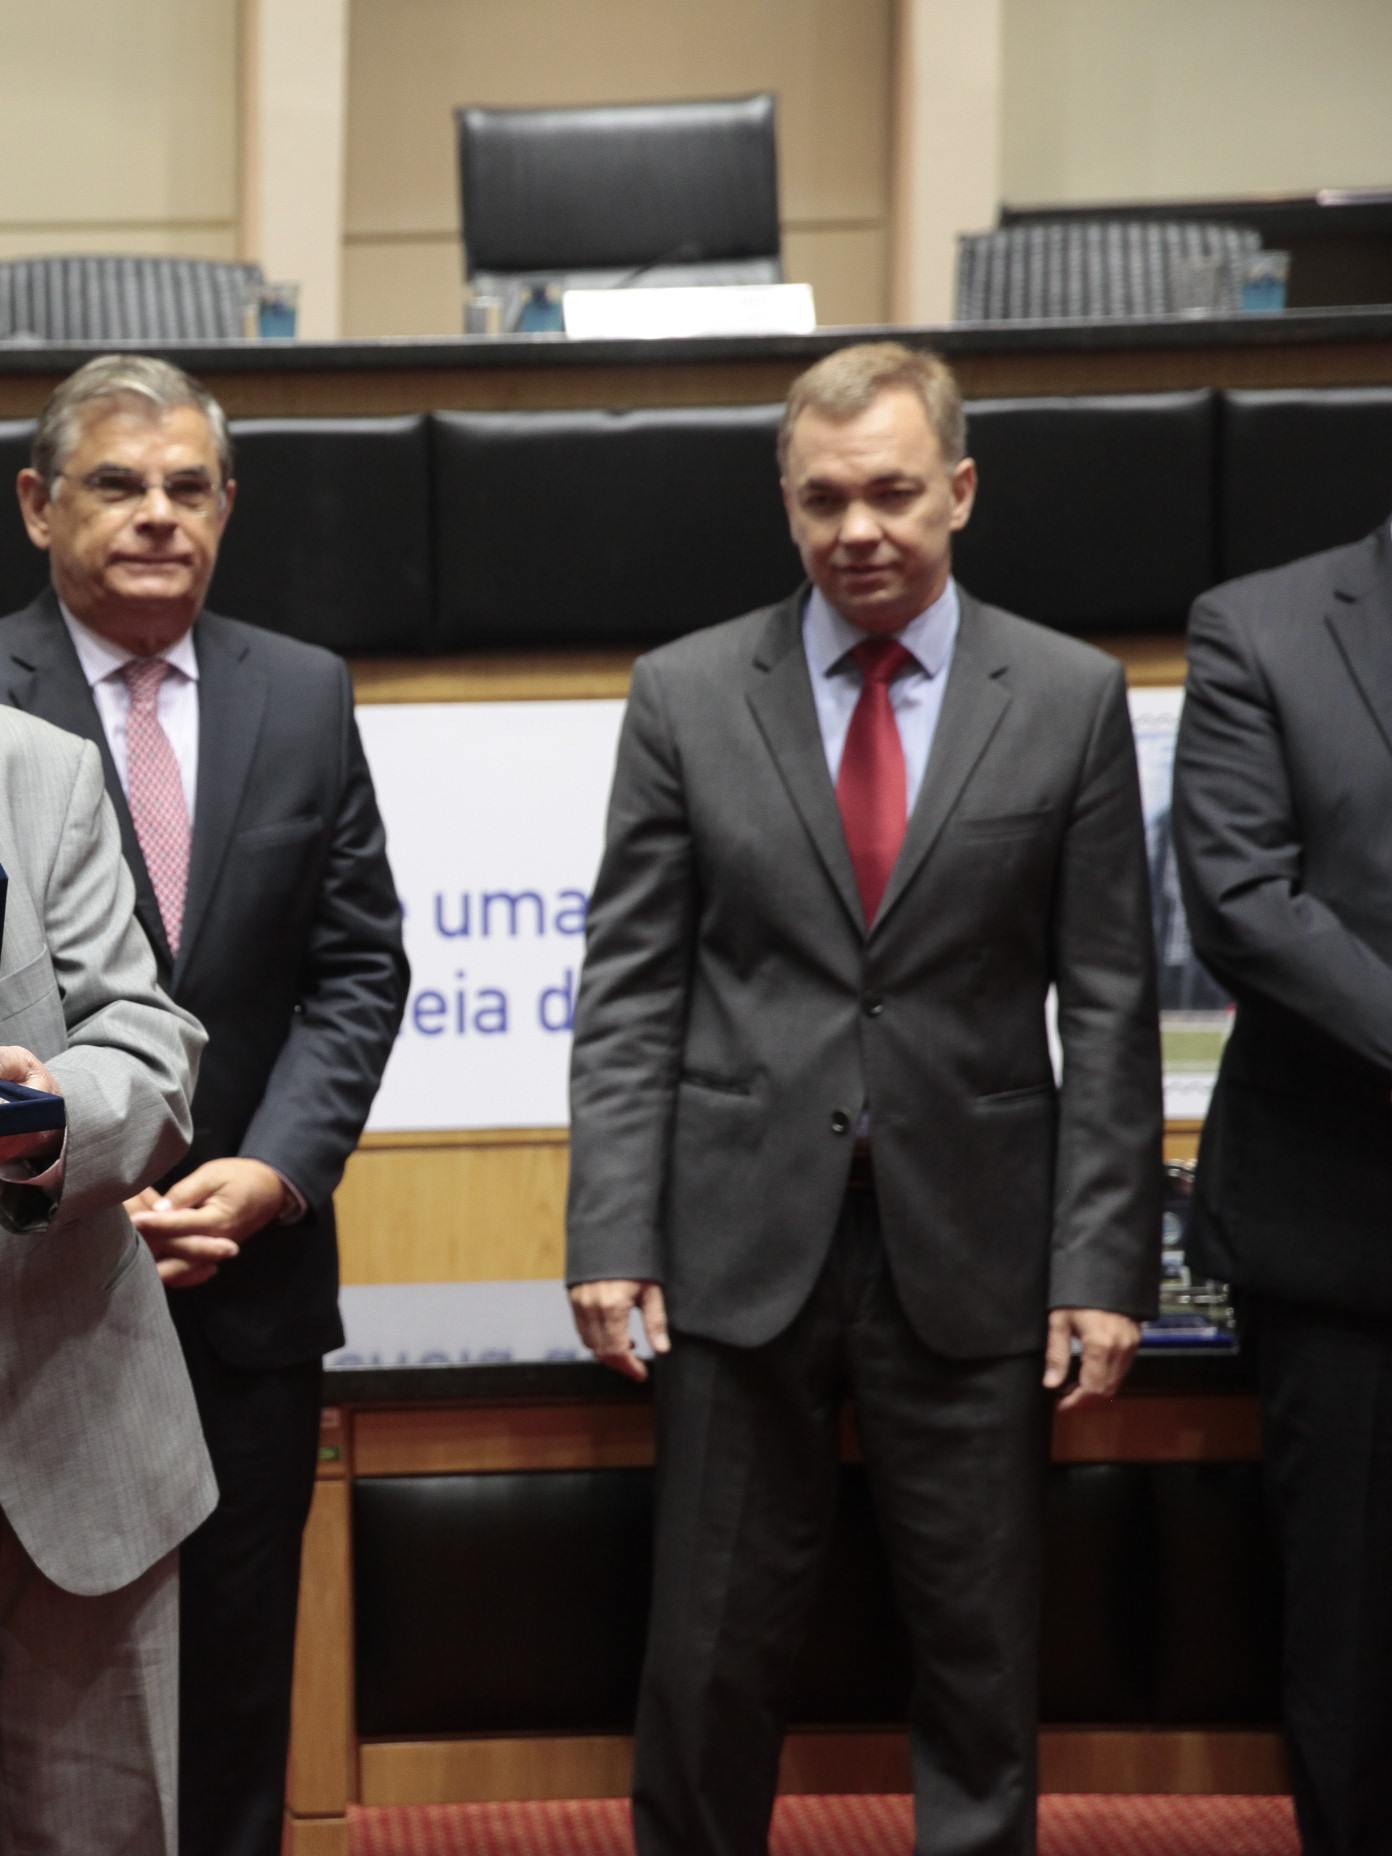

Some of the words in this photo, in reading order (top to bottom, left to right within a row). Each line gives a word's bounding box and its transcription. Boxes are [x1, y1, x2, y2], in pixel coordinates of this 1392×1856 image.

[434, 889, 587, 938] uma
[399, 967, 508, 1036] eia
[539, 967, 575, 1032] d
